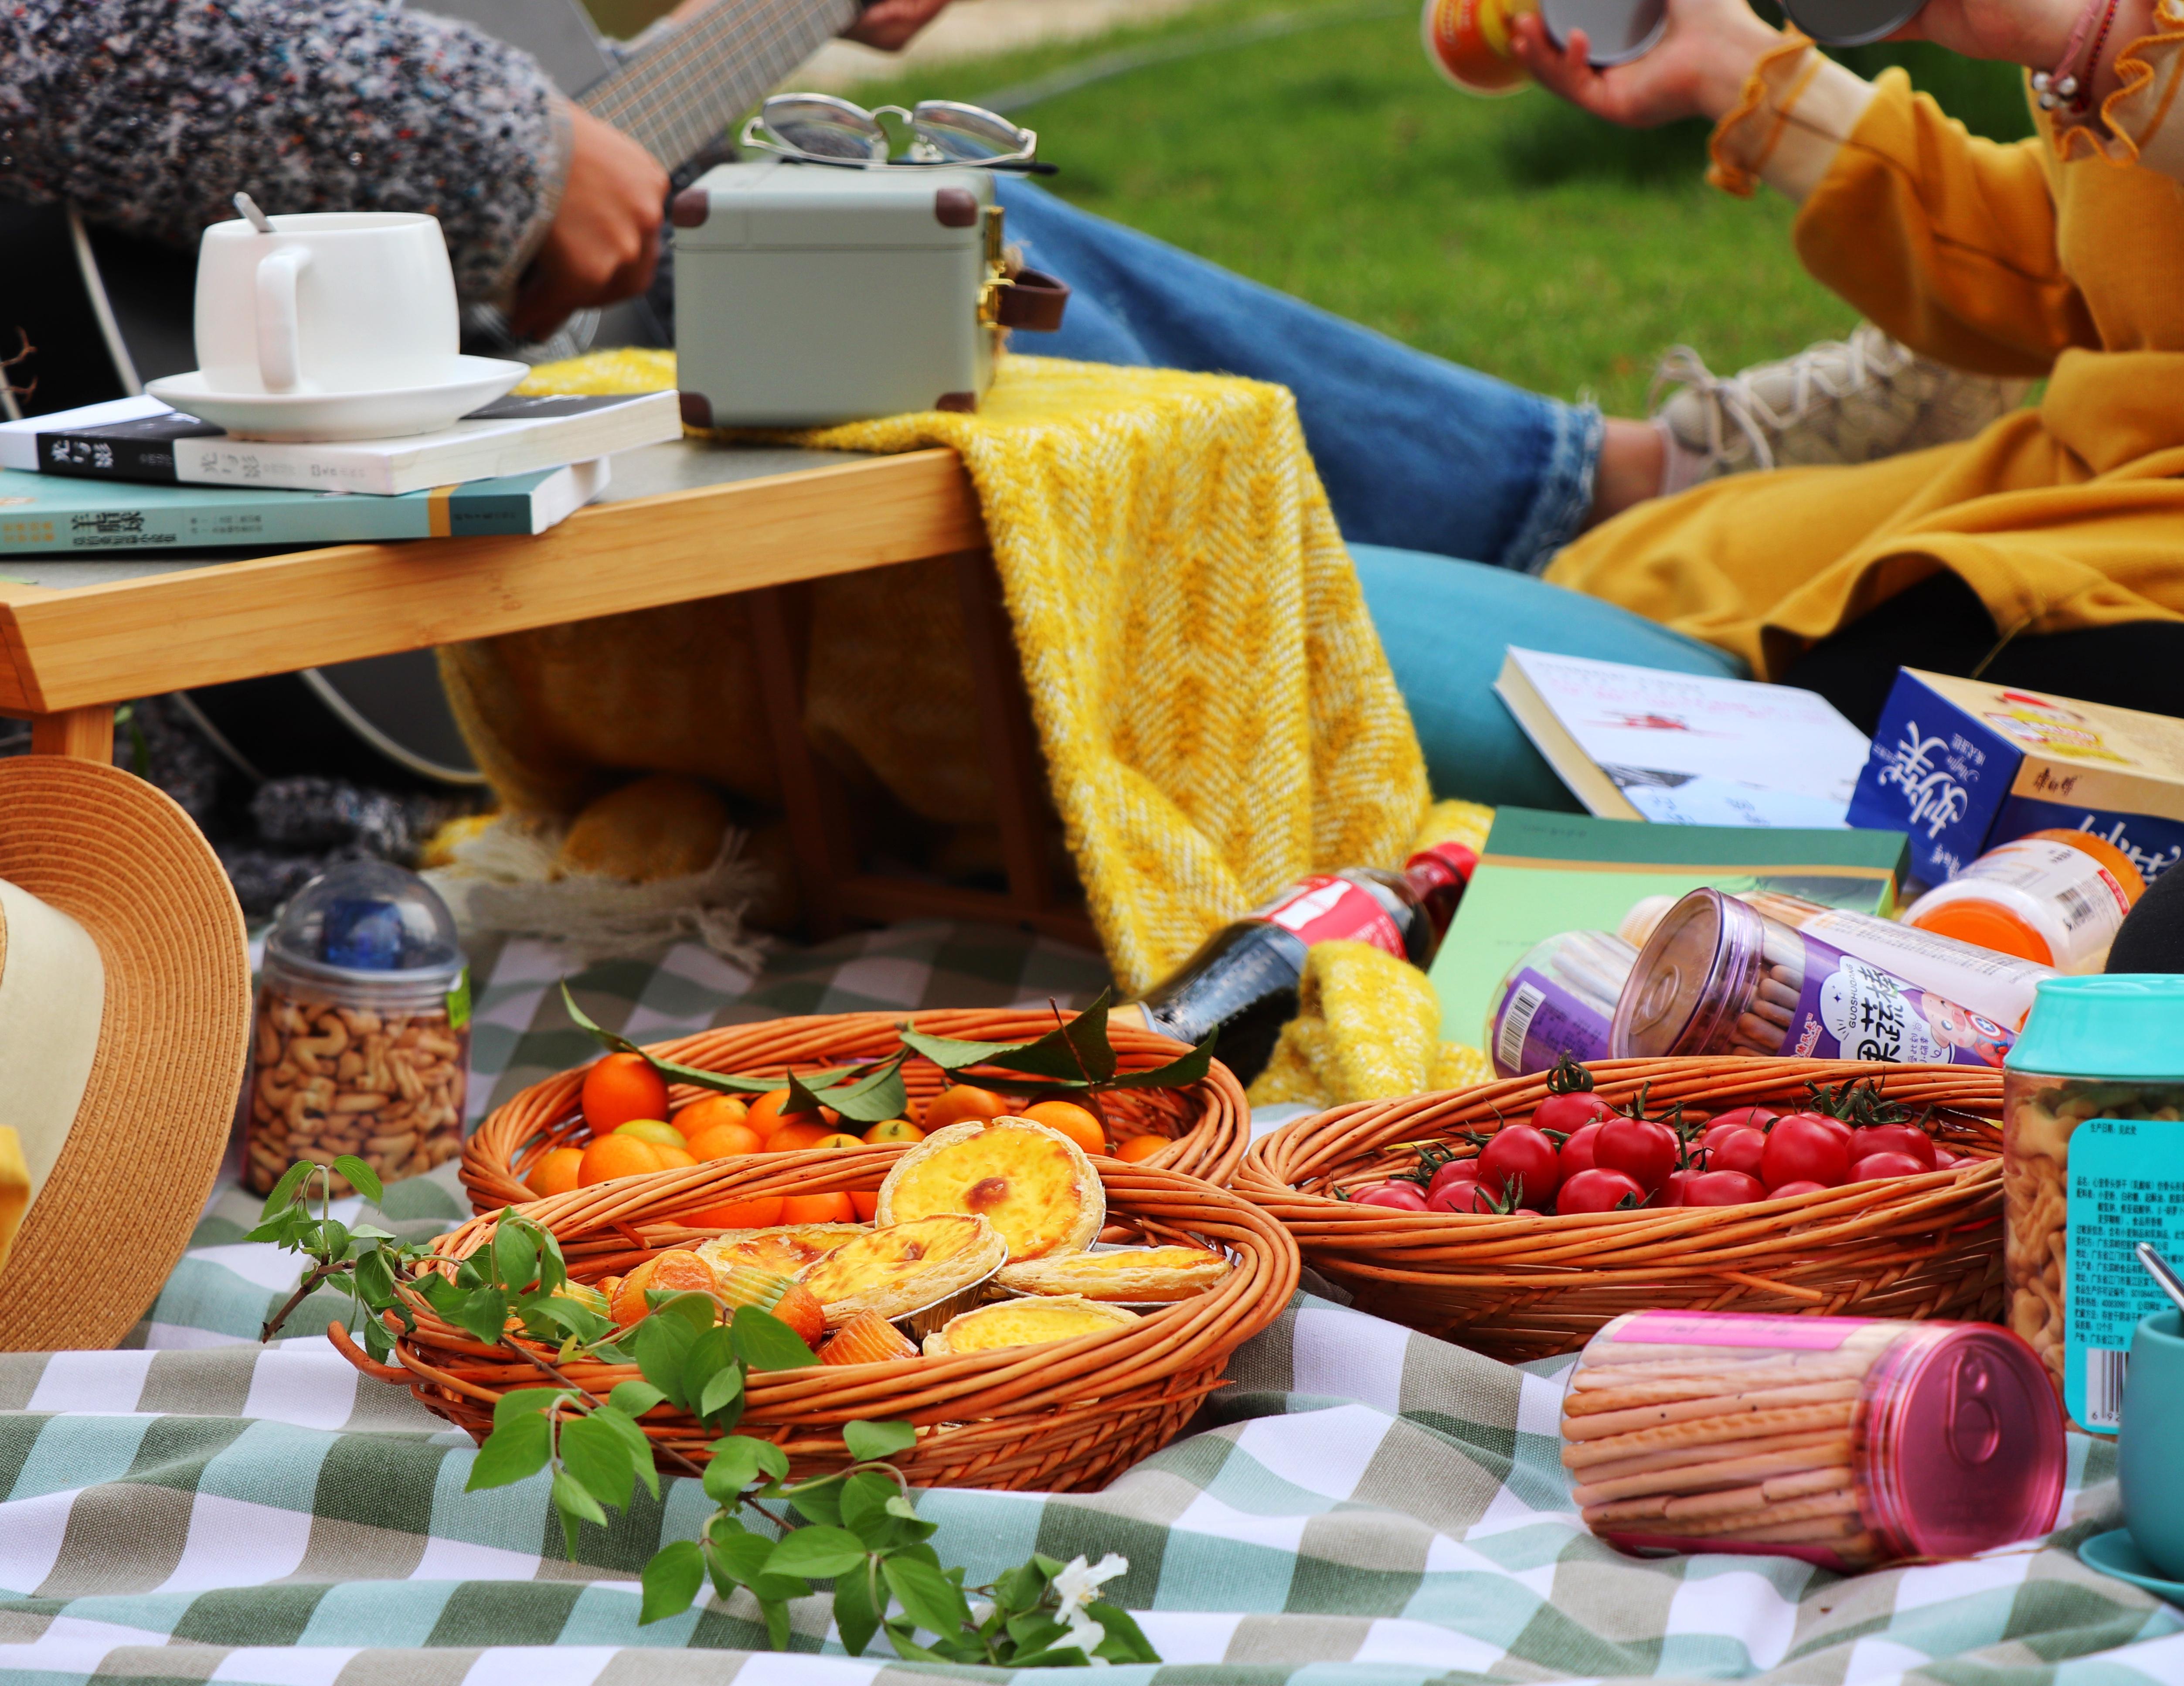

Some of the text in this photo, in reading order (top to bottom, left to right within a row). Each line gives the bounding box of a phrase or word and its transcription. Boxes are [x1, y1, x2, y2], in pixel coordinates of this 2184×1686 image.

[1878, 720, 1968, 840] 妙芙
[1846, 963, 1859, 1029] GUOSHUBANG
[1857, 966, 1906, 1063] 果蔬棒
